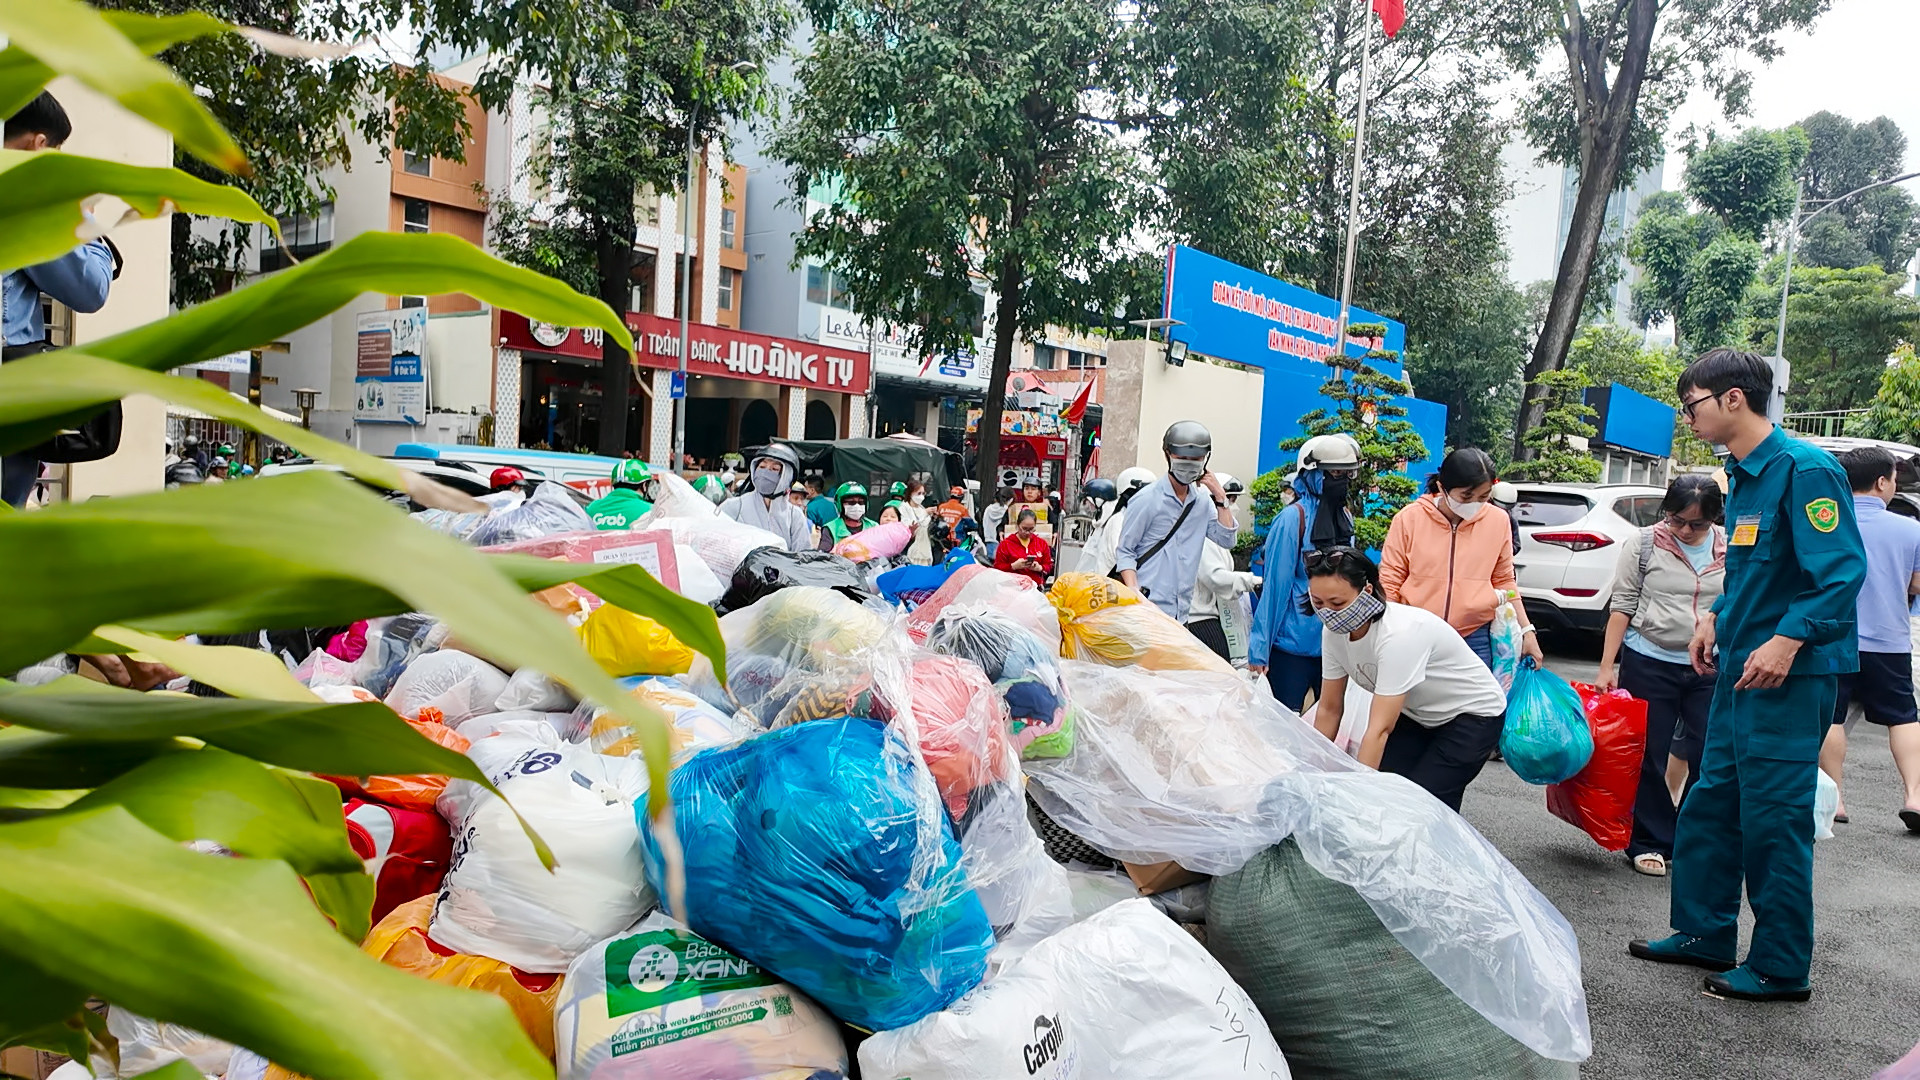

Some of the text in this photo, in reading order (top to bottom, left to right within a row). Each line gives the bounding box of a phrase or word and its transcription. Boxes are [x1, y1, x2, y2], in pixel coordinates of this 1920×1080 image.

[1213, 281, 1229, 306] ĐOÀN
[826, 314, 842, 335] Le
[1268, 327, 1280, 351] VĂN
[824, 356, 854, 386] TY
[593, 513, 626, 526] Grab
[1224, 609, 1232, 628] true
[685, 941, 729, 960] Bác
[629, 1025, 655, 1038] online
[656, 1021, 668, 1031] tại
[670, 1017, 688, 1027] web
[689, 998, 768, 1022] Bachhoaxanh.com
[640, 1036, 655, 1049] phí
[657, 1032, 680, 1045] giao
[1023, 1011, 1065, 1076] Cargill
